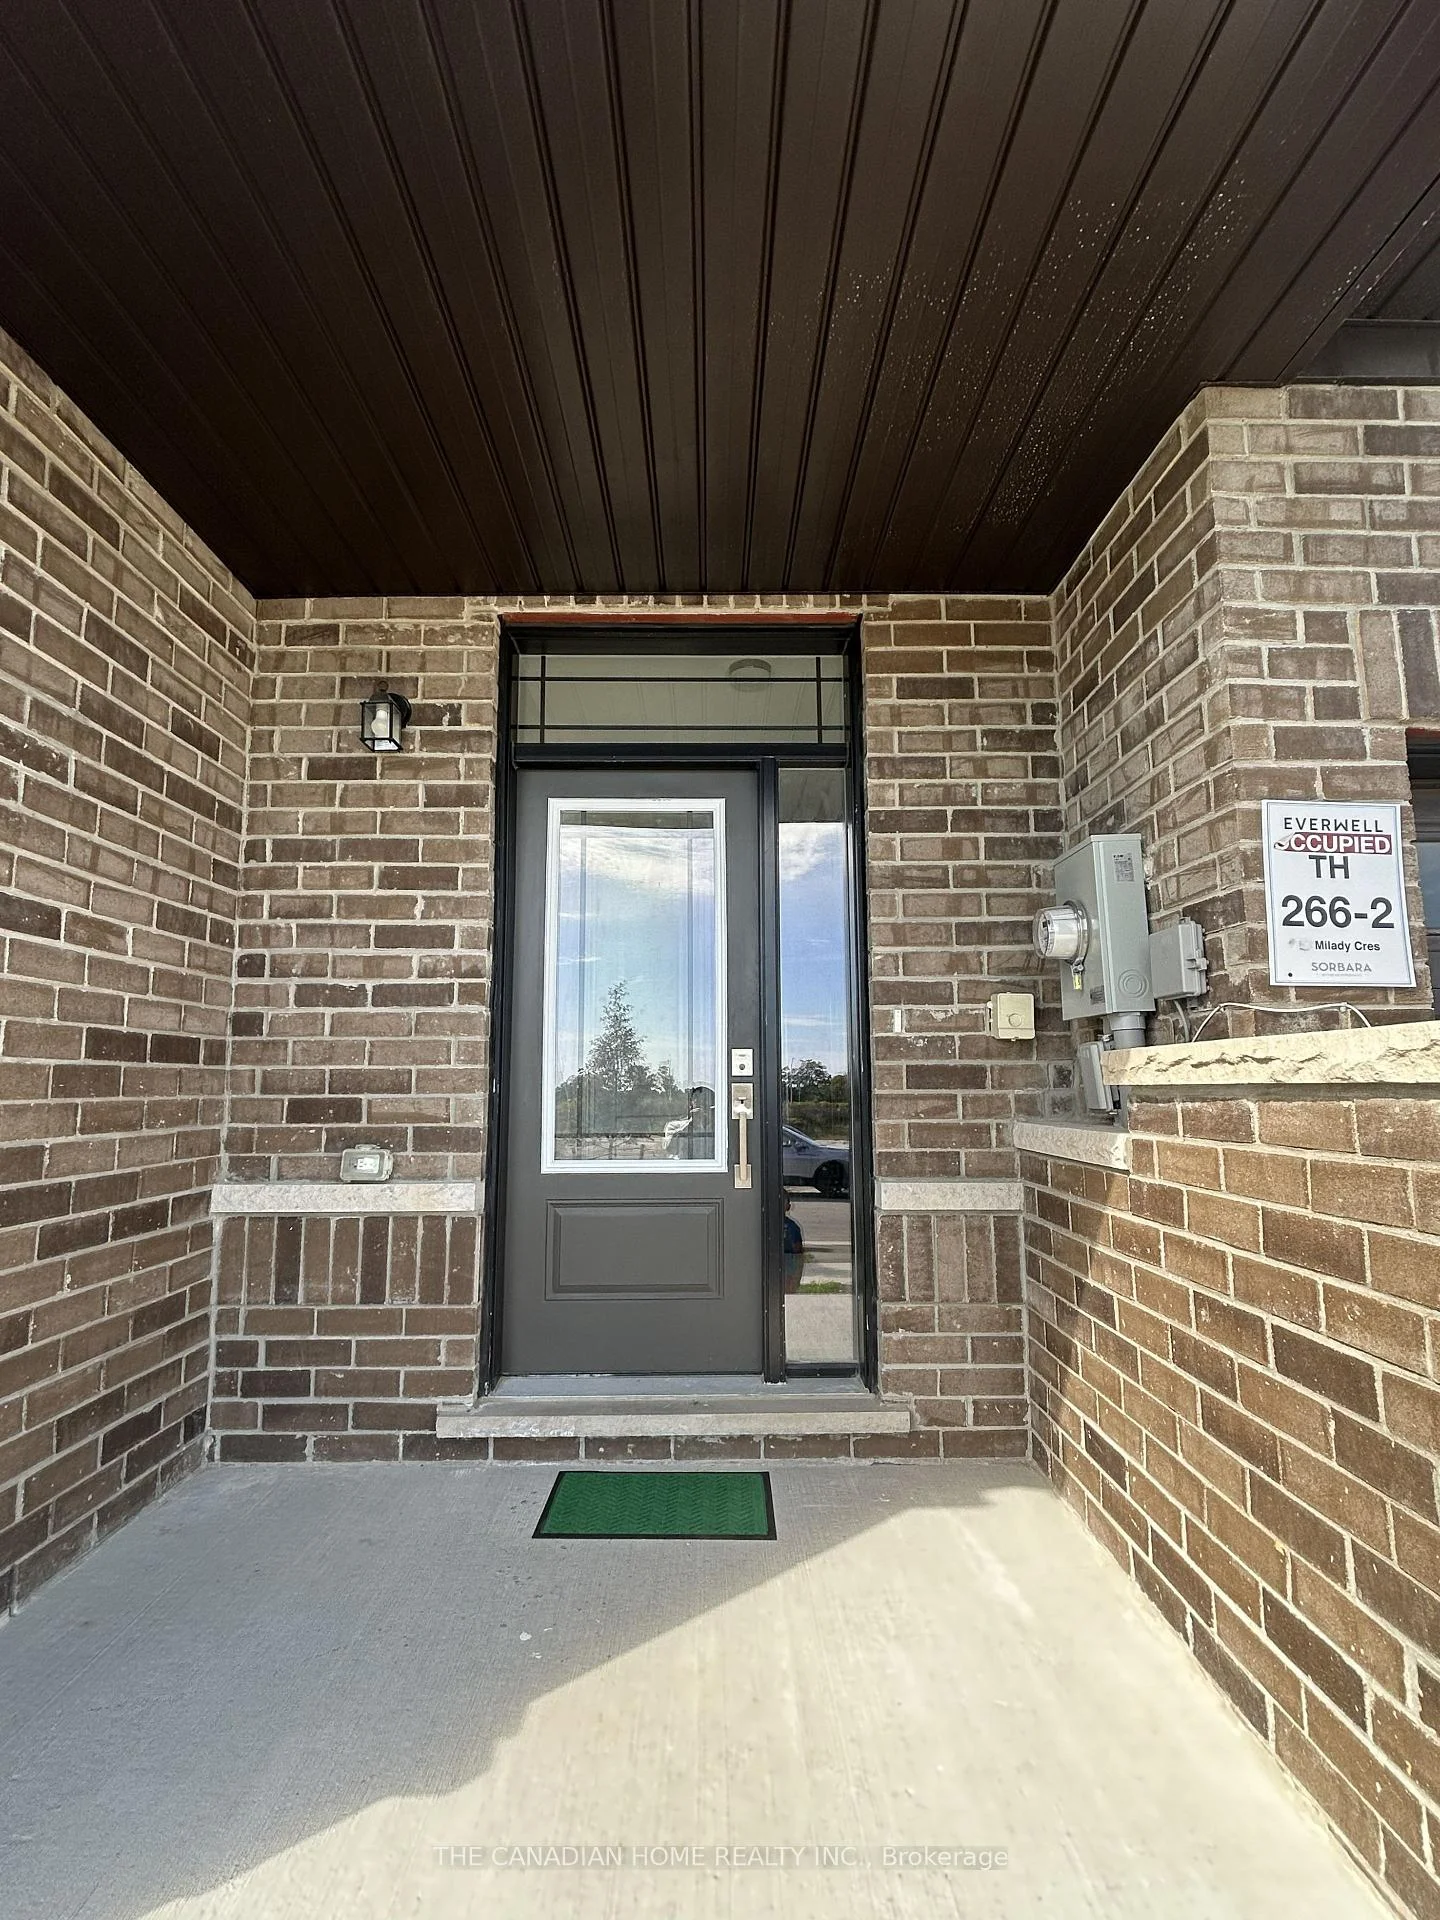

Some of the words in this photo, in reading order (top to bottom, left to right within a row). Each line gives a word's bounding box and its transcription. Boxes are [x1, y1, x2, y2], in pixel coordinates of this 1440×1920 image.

[1284, 817, 1383, 832] EVERWELL
[1308, 855, 1350, 879] TH
[1281, 894, 1395, 929] 266-2
[1315, 940, 1351, 953] Milady
[1354, 941, 1381, 951] Cres
[1311, 962, 1372, 972] SORBARA
